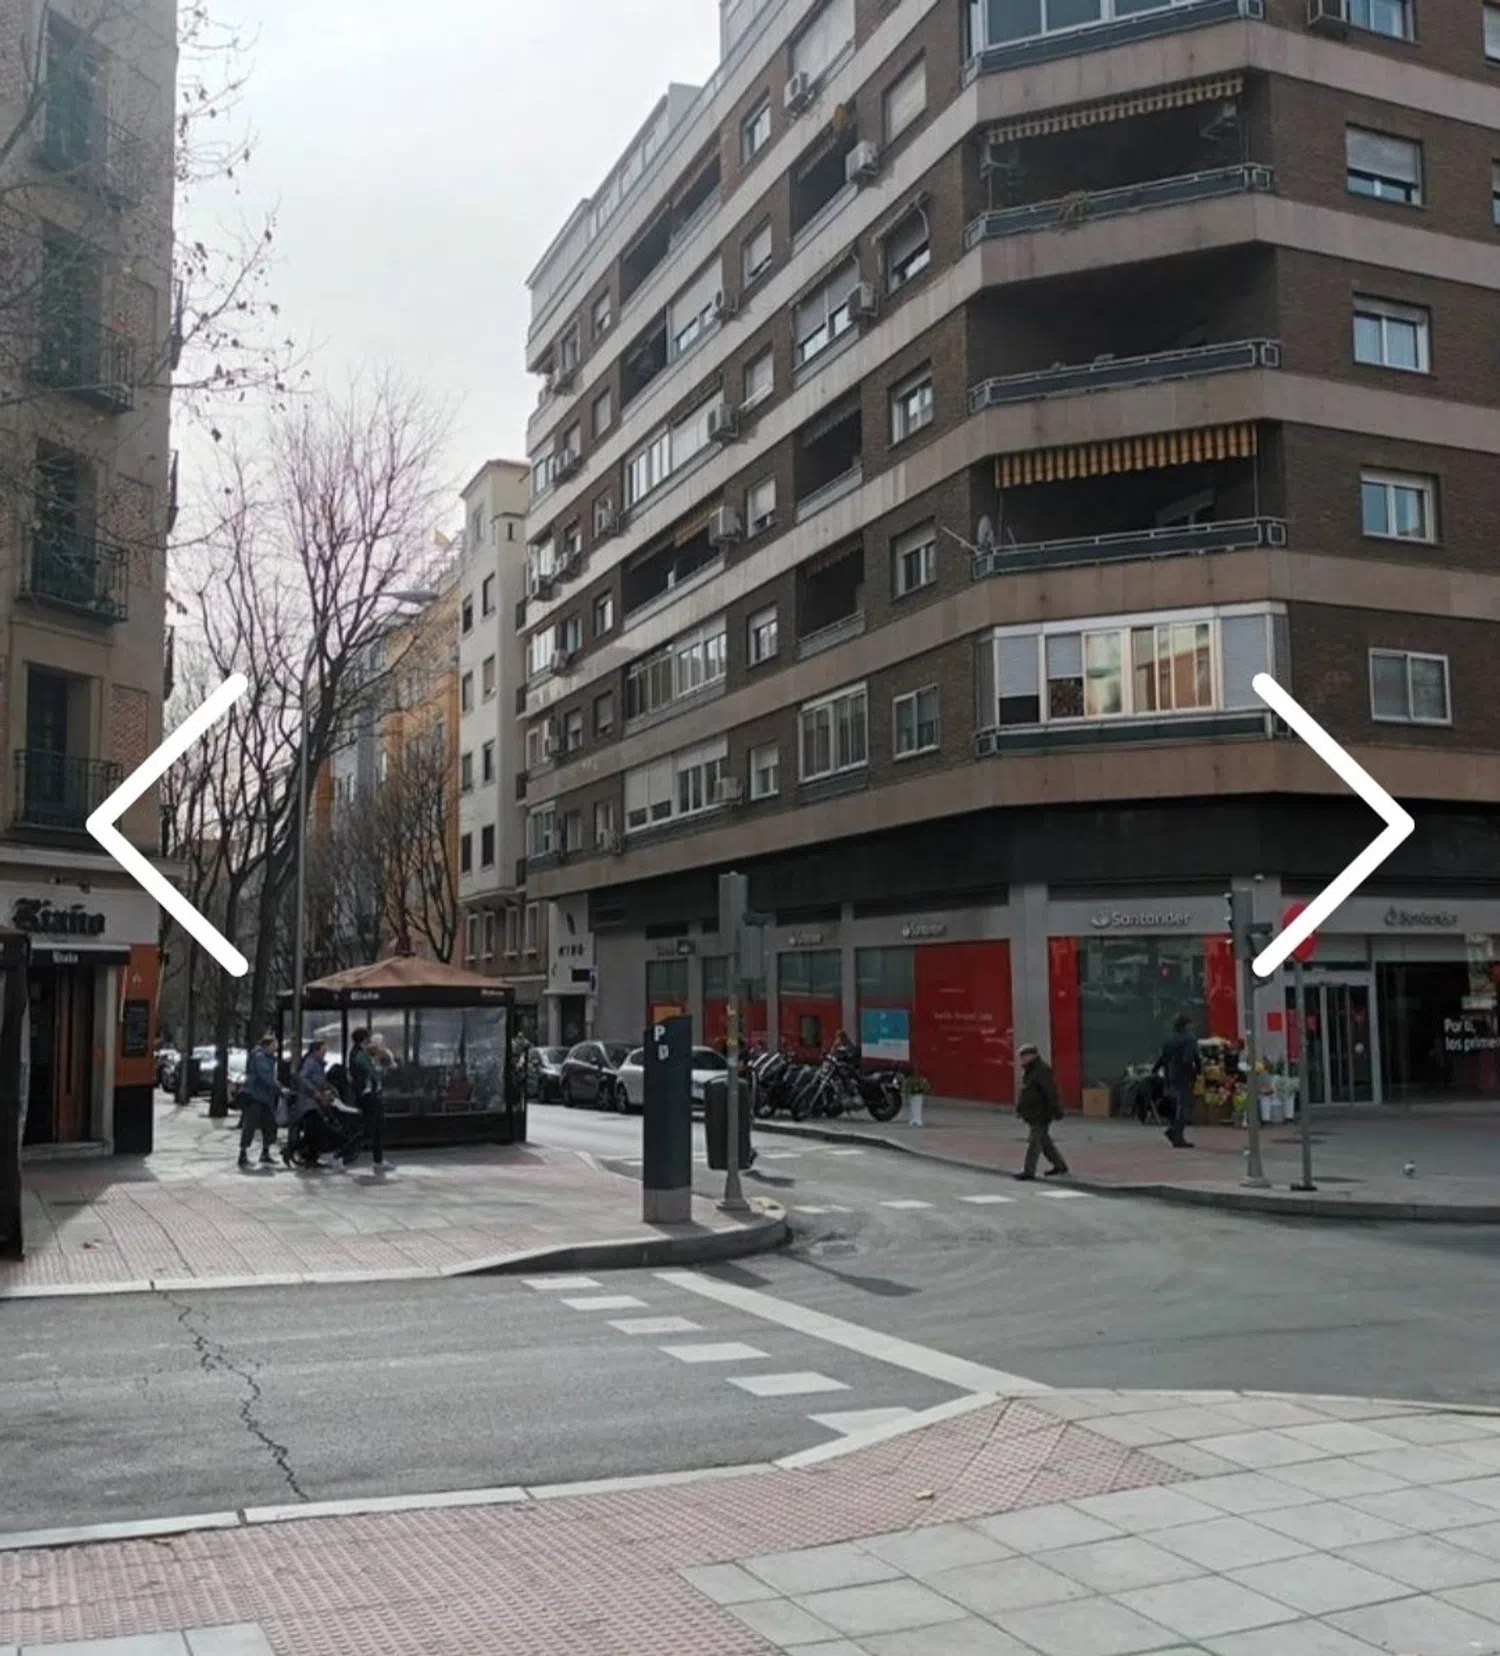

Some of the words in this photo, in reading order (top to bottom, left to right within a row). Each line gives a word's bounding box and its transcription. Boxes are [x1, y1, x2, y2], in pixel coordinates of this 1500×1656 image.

[1111, 911, 1191, 927] Santander
[653, 1025, 666, 1042] P
[1445, 1036, 1463, 1051] los
